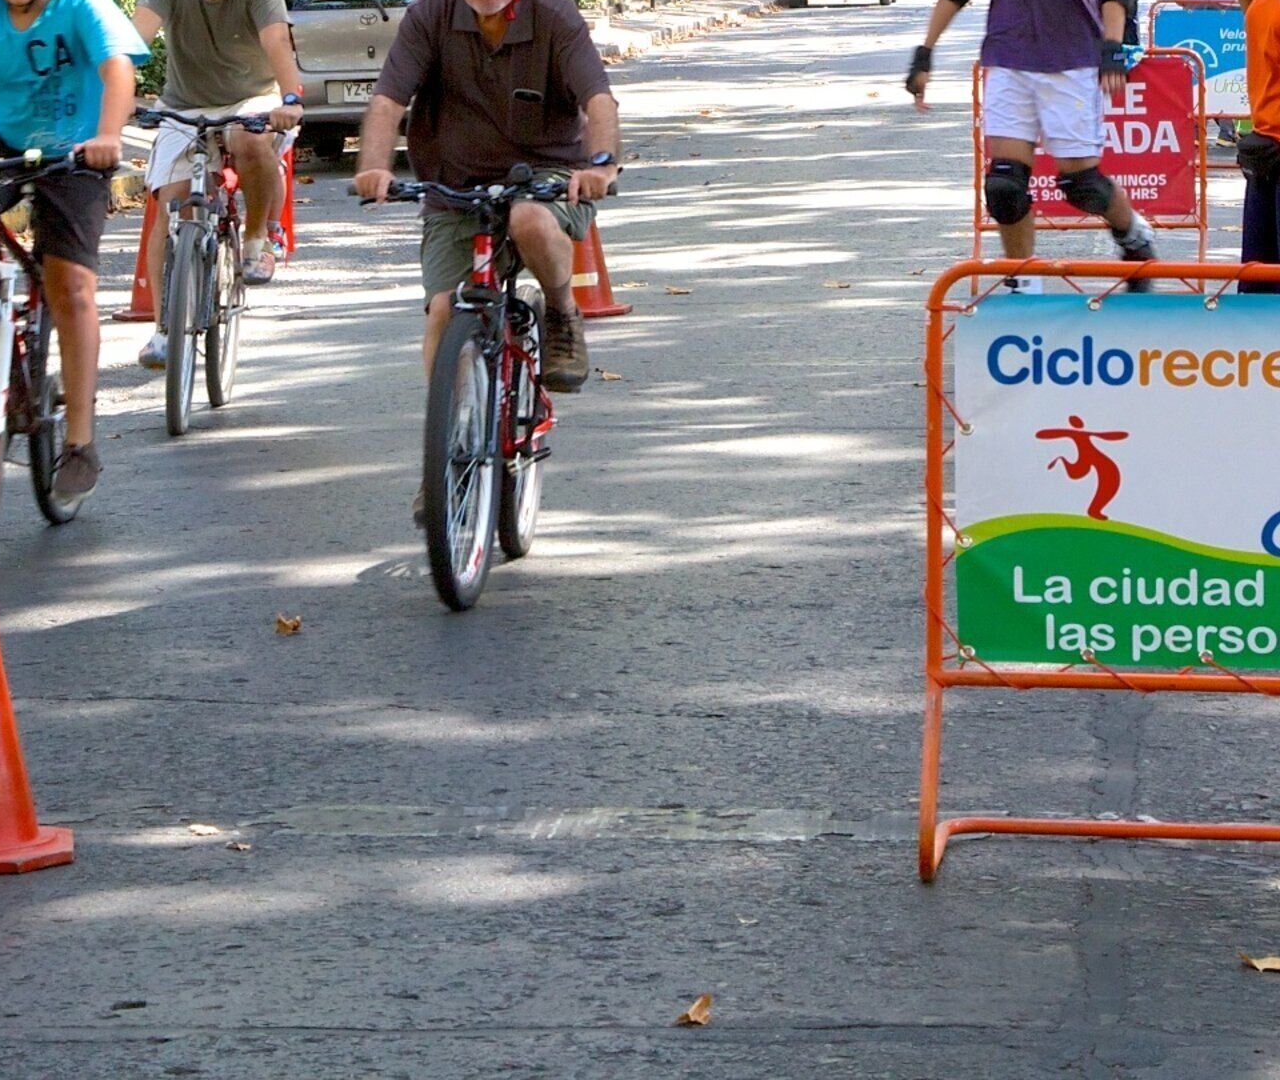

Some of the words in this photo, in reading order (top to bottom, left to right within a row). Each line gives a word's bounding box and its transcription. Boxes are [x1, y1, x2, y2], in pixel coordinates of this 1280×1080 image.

[1220, 28, 1247, 40] Velo
[1103, 82, 1147, 115] LE
[1100, 120, 1181, 154] ADA
[1028, 176, 1057, 188] DOS
[1111, 174, 1167, 186] MINGOS
[1131, 188, 1159, 200] HRS
[1013, 566, 1073, 605] La
[1089, 568, 1265, 607] ciudad
[1045, 614, 1115, 652] las
